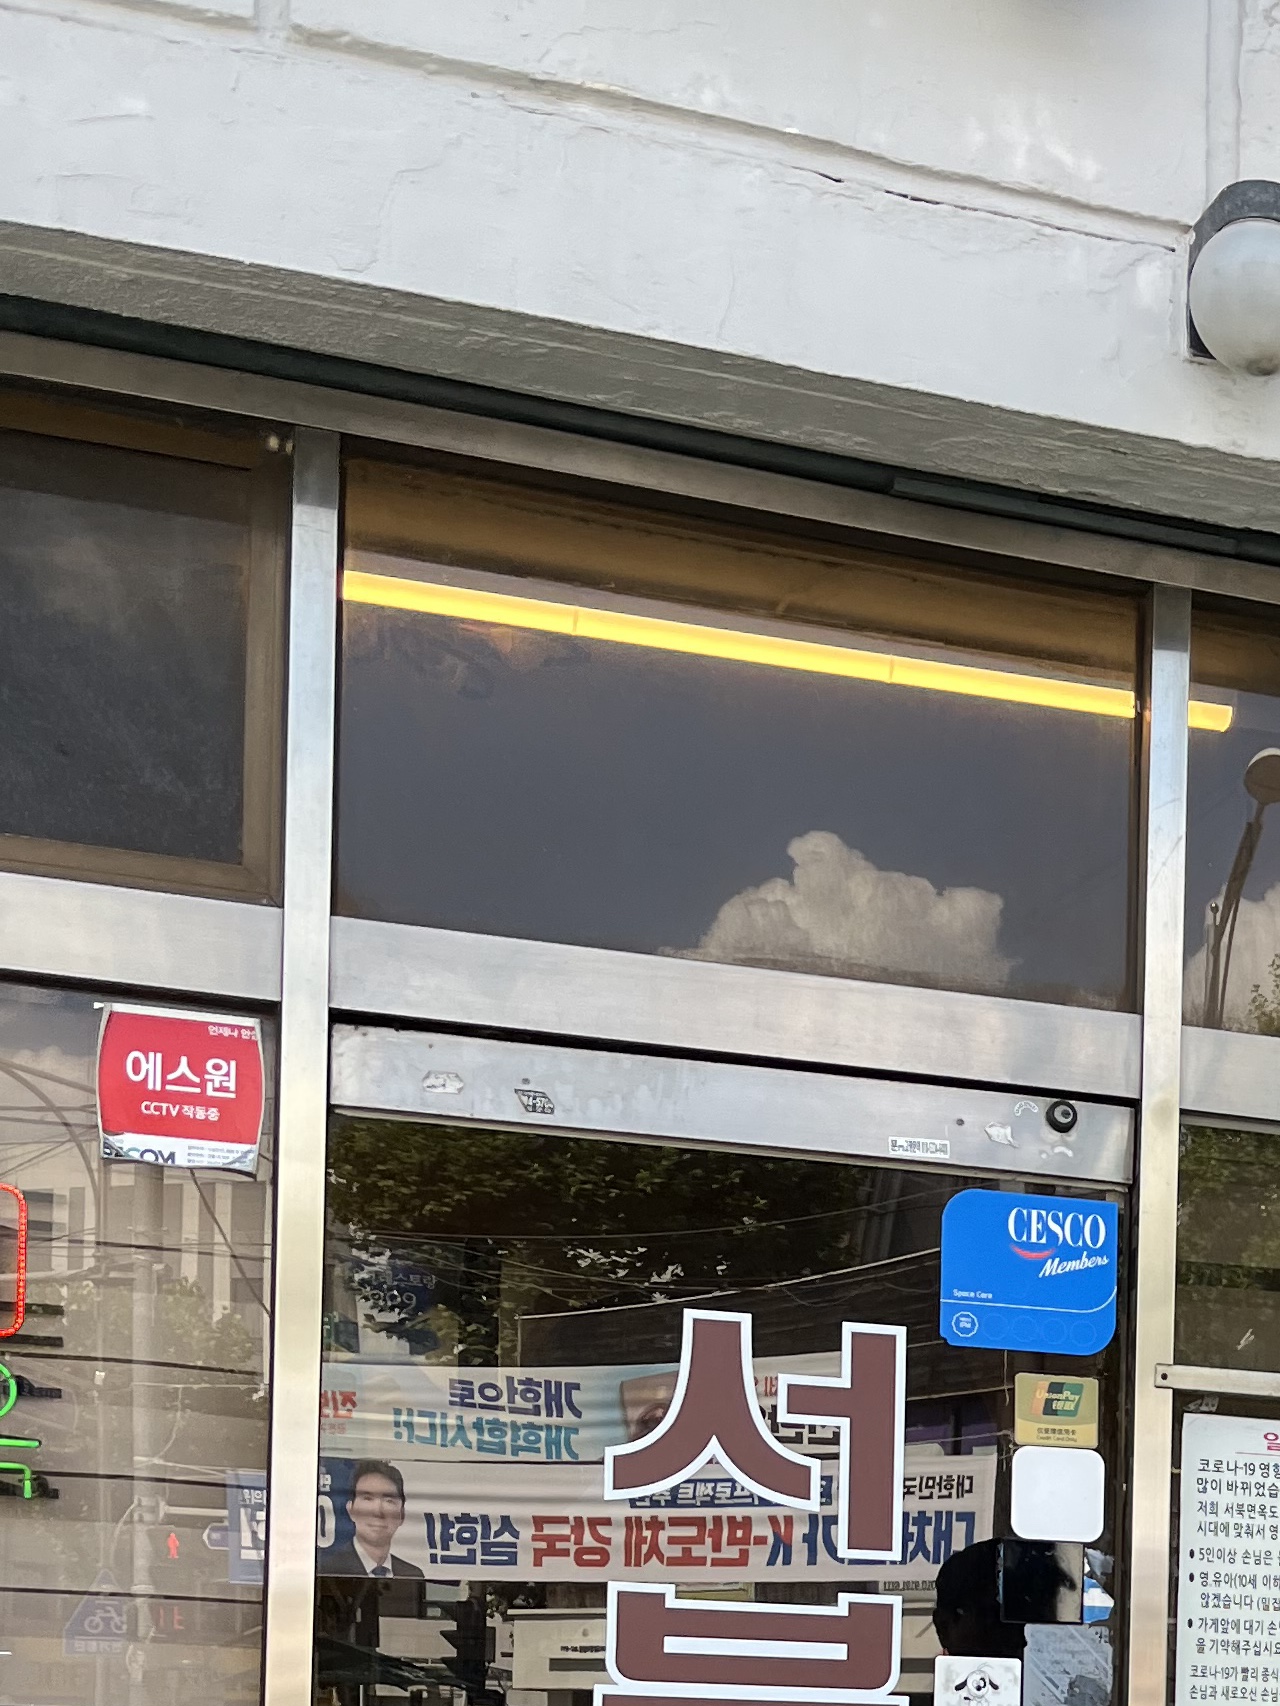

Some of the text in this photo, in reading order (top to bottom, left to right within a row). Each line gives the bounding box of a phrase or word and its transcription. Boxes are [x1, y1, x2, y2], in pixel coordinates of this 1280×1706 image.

[125, 1049, 237, 1099] 에스원
[140, 1101, 220, 1121] CCTV 작동중
[1007, 1207, 1107, 1249] CESCO
[1039, 1251, 1109, 1278] Members
[1035, 1389, 1081, 1403] UnionPay
[1197, 1458, 1256, 1477] 코로나-19
[1196, 1477, 1222, 1495] 많이
[1197, 1500, 1219, 1517] 저희
[1224, 1502, 1279, 1520] 서북면옥도
[1197, 1520, 1230, 1537] 시대에
[1233, 1522, 1266, 1540] 맞춰서
[1198, 1547, 1238, 1564] 5인이상
[1241, 1548, 1274, 1566] 손님은
[1200, 1592, 1254, 1610] 않겠습니다
[1198, 1617, 1241, 1634] 가게앞에
[1243, 1619, 1264, 1635] 대기
[1195, 1637, 1206, 1654] 을
[1190, 1664, 1238, 1681] 코로나-19가
[1240, 1666, 1259, 1682] 빨리
[1189, 1684, 1218, 1700] 손님과
[1221, 1685, 1257, 1702] 새로오신
